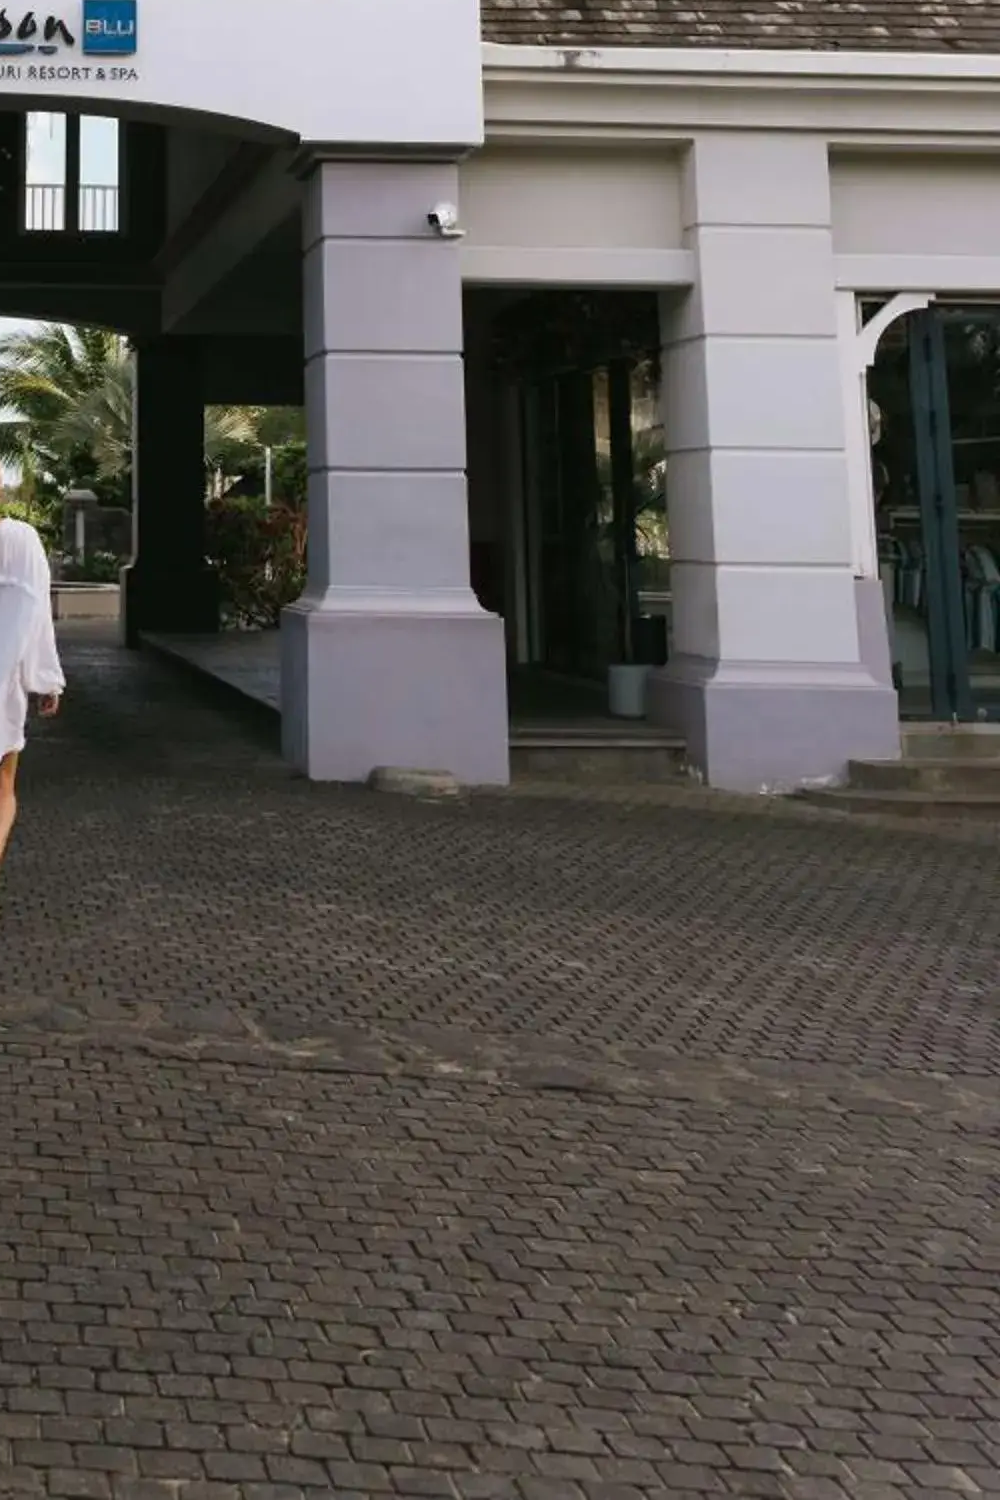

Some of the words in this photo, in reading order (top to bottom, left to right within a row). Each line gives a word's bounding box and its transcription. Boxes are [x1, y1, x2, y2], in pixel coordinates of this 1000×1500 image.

[85, 19, 135, 35] BLU
[27, 66, 91, 80] RESORT
[95, 67, 106, 80] &
[110, 67, 139, 81] SPA
